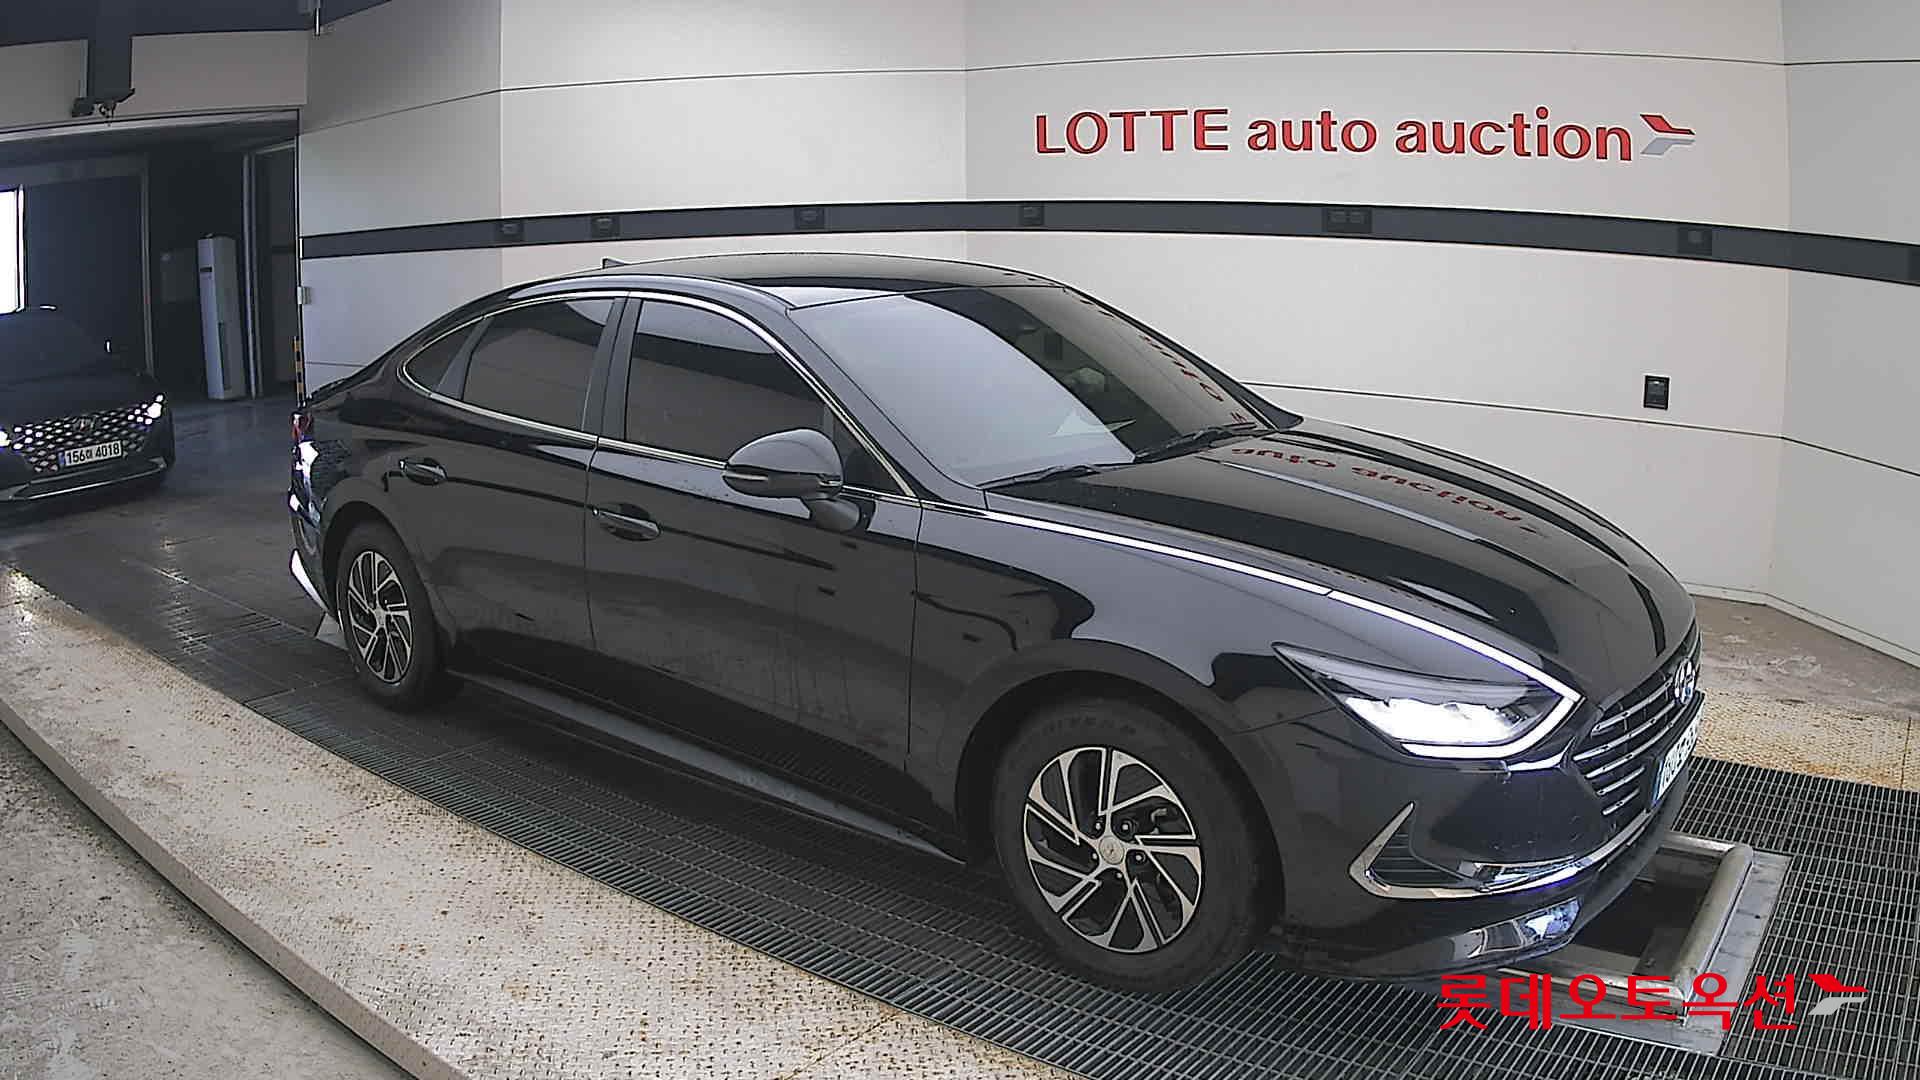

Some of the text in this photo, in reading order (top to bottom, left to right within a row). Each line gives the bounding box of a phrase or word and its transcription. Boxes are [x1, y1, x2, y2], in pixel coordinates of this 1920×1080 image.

[1035, 105, 1633, 162] LOTTE auto auction
[95, 443, 120, 458] 4018
